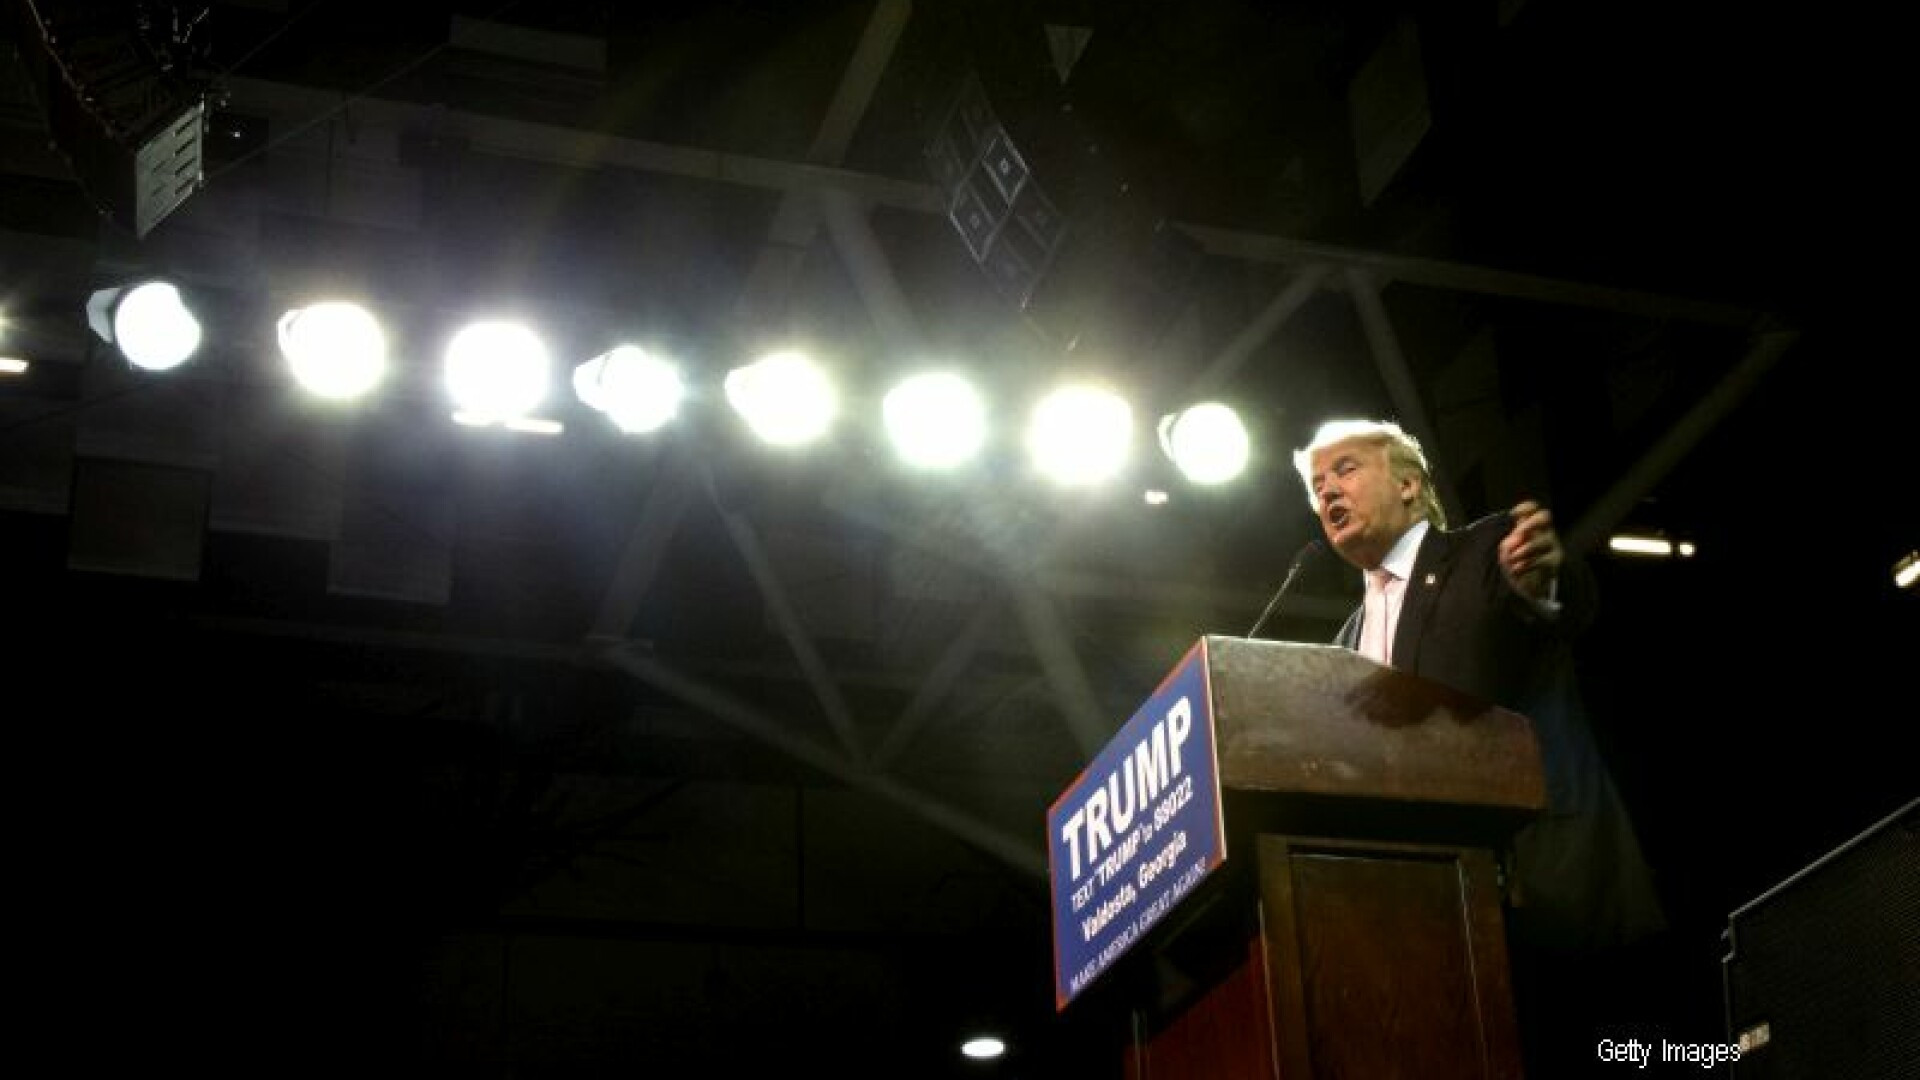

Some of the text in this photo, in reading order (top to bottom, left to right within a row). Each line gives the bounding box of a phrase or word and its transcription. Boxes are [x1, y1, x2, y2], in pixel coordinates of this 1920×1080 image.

[1062, 695, 1191, 881] TRUMP
[1072, 877, 1093, 912] TEXT
[1154, 775, 1194, 831] 88022
[1082, 830, 1187, 941] Valdosta, Georgia
